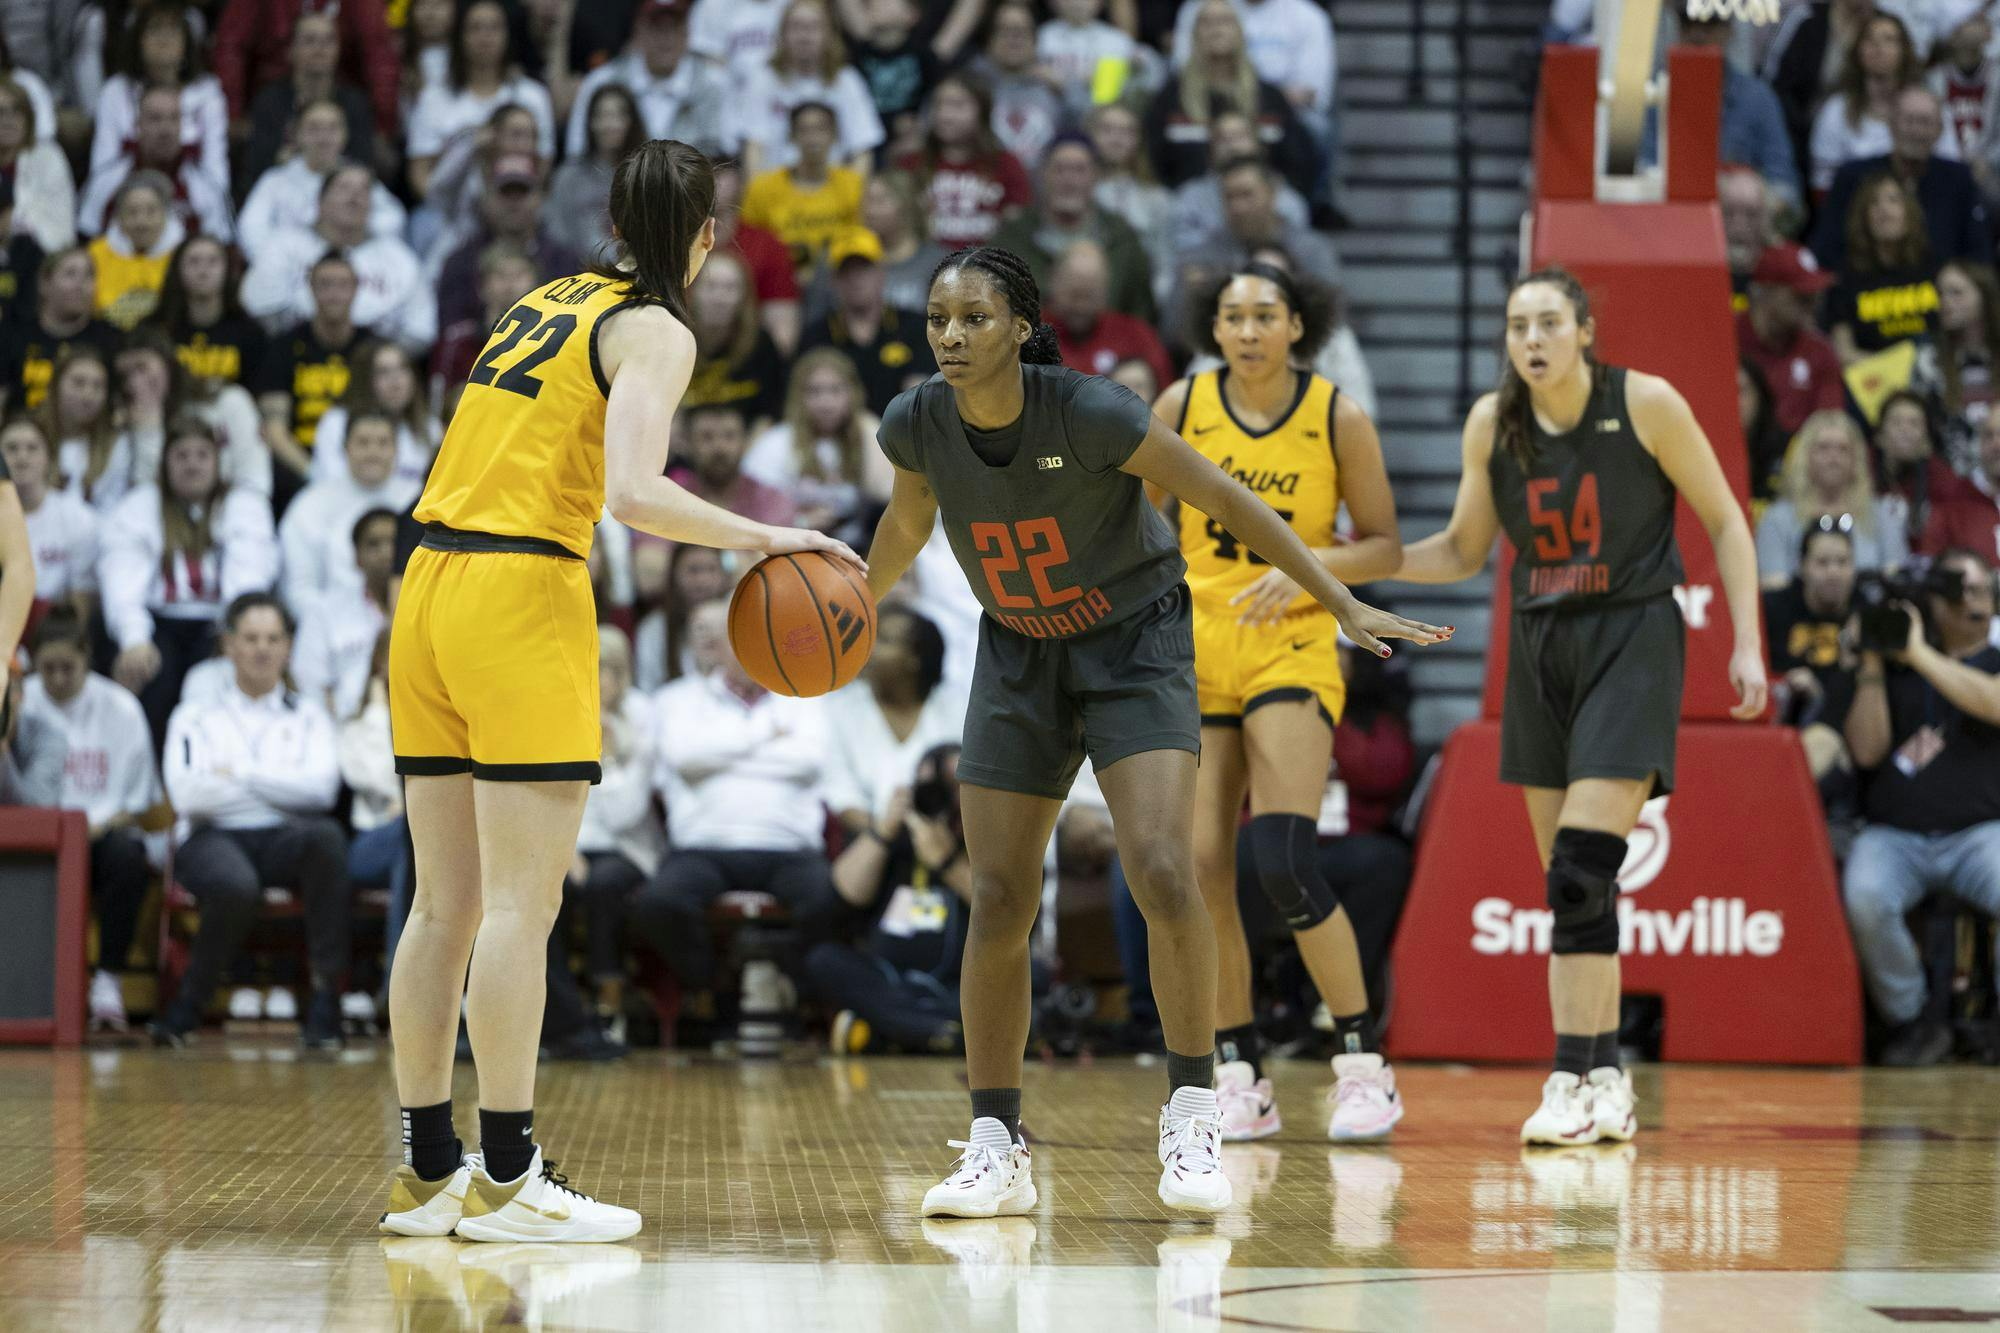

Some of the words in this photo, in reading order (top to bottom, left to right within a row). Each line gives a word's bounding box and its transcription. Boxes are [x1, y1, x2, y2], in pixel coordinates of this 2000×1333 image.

[466, 304, 578, 400] 22
[1205, 508, 1294, 565] 4
[1526, 472, 1603, 561] 54
[970, 516, 1084, 609] 22
[996, 586, 1113, 639] INDIANA
[1471, 895, 1785, 957] Smhville
